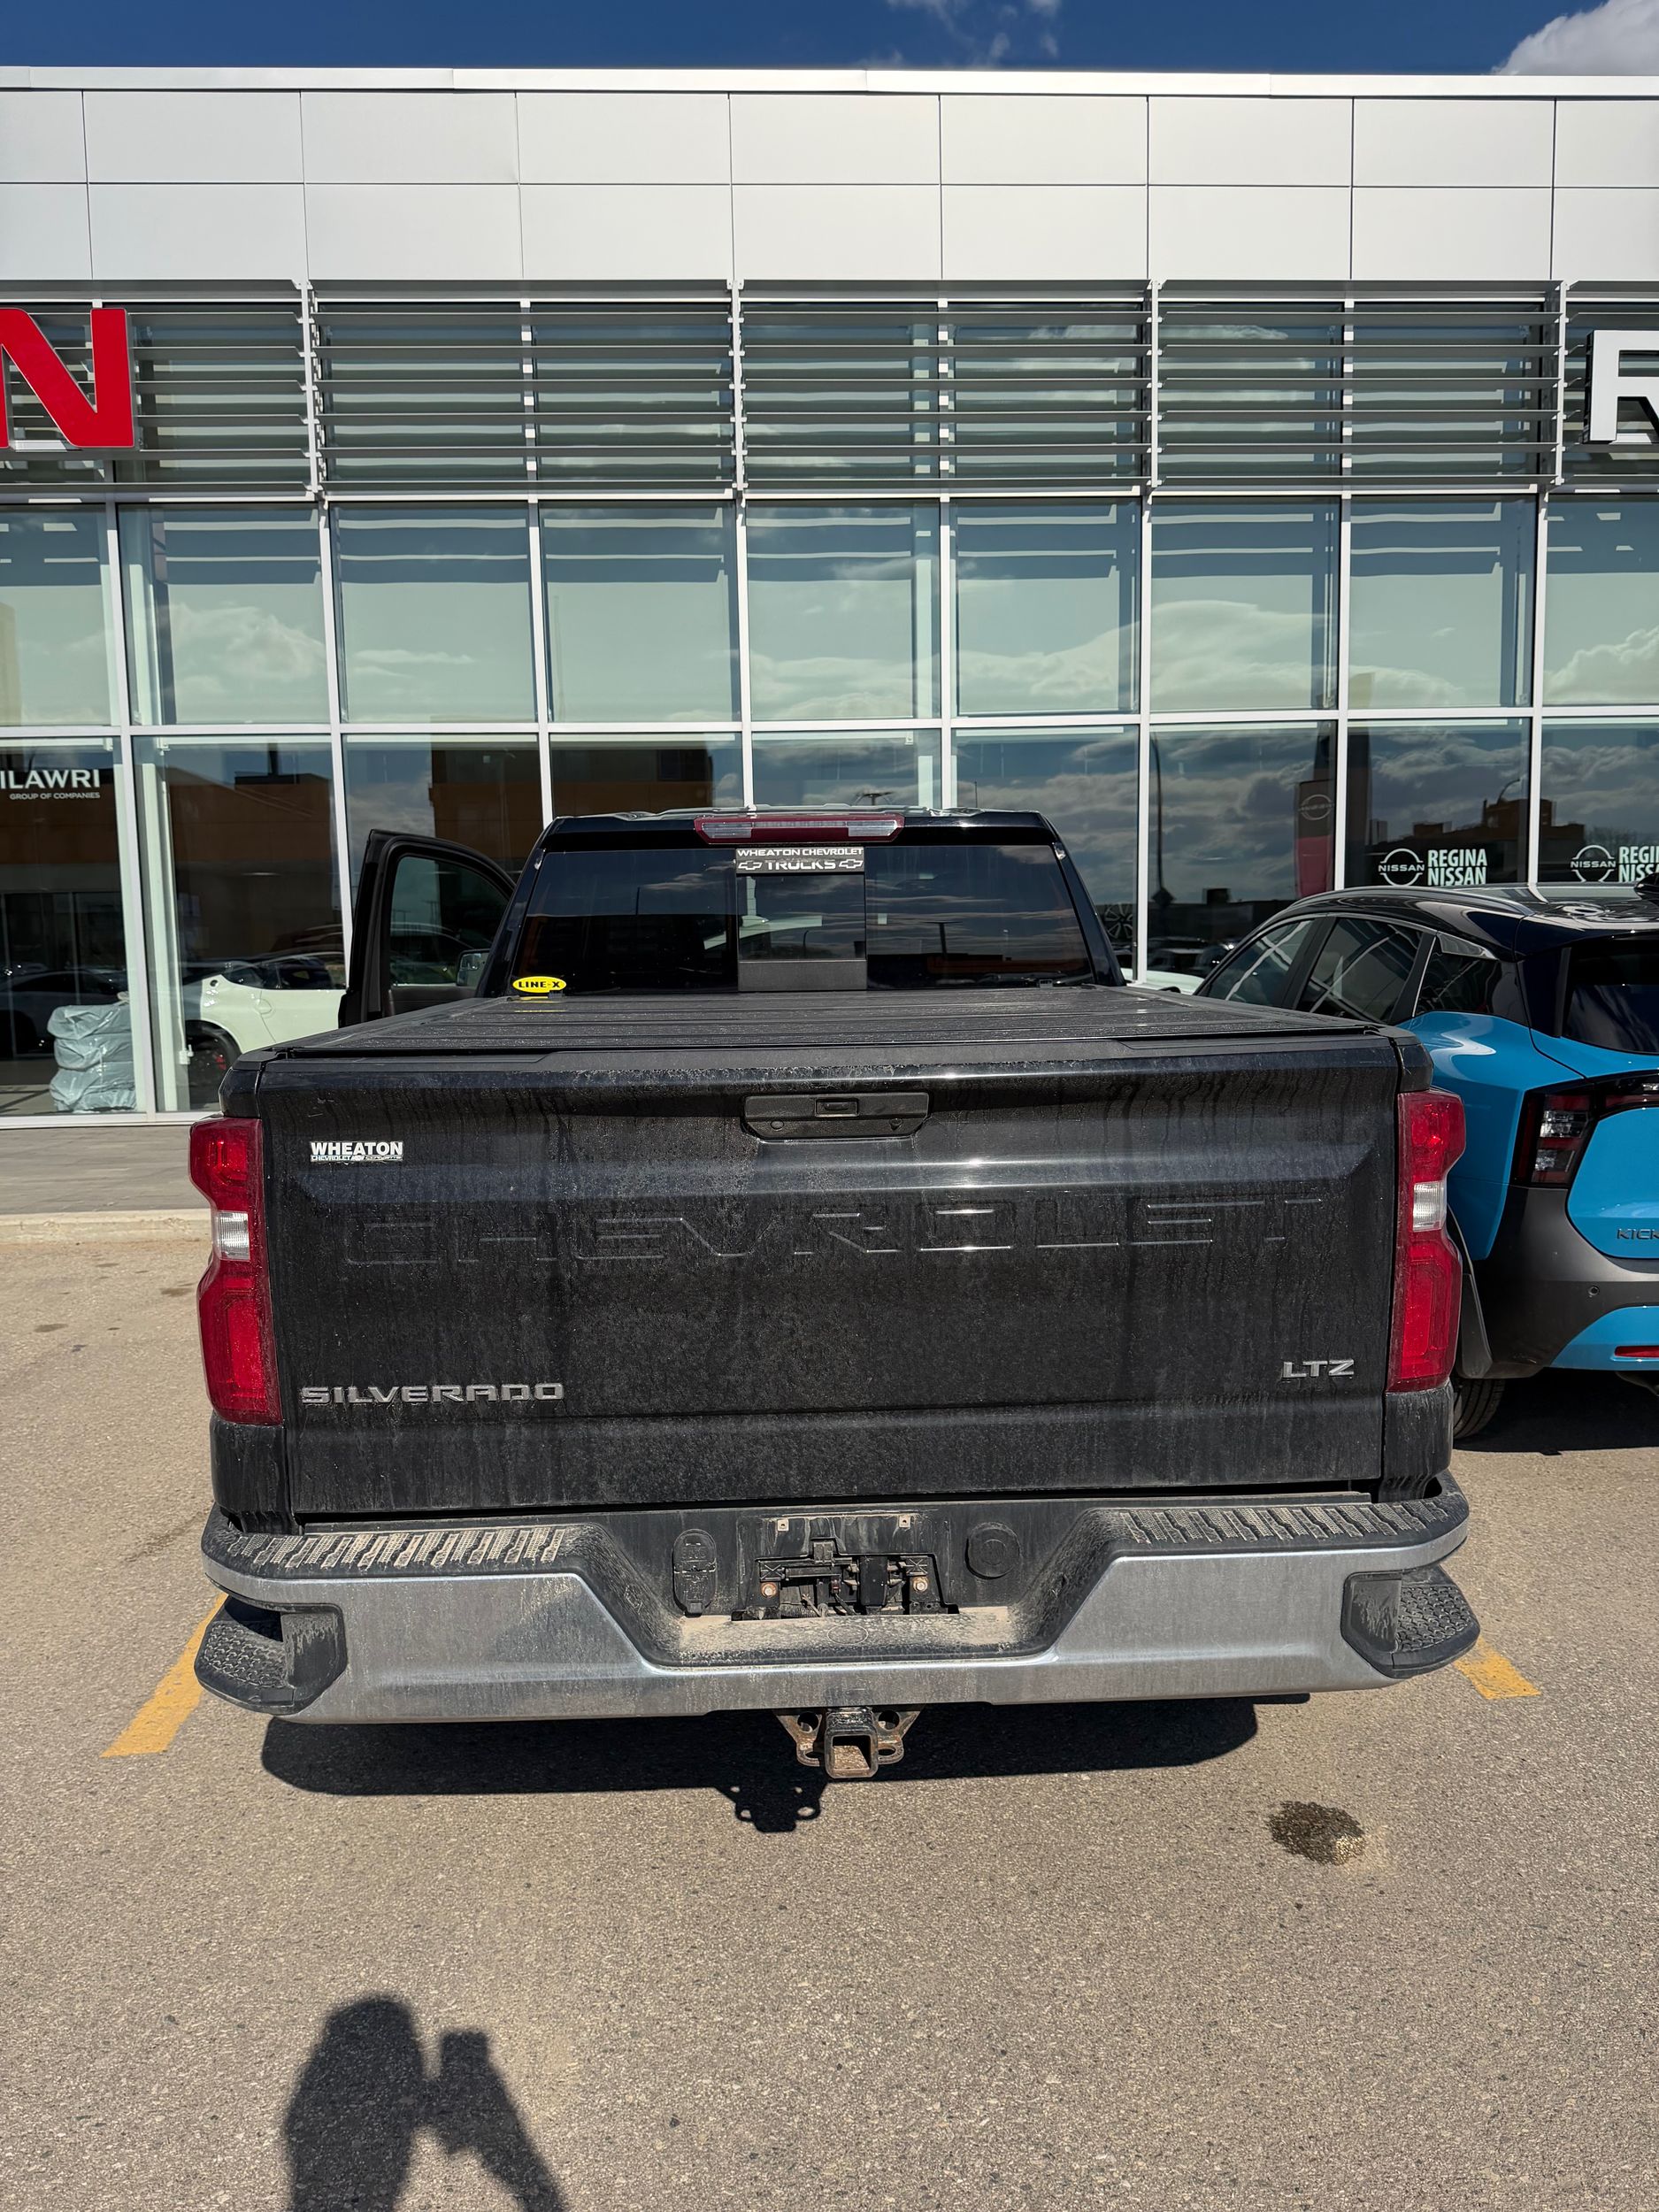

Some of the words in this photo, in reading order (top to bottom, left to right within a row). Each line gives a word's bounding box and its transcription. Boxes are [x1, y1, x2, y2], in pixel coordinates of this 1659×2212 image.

[0, 308, 134, 449] N
[1590, 330, 1659, 441] R
[0, 769, 100, 789] ILAWRI
[765, 859, 836, 870] TRUCKS
[1427, 849, 1487, 867] REGINA
[1427, 867, 1486, 887] NISSAN
[311, 1142, 403, 1156] WHEATON
[343, 1199, 1323, 1263] CHEVROLET
[1283, 1360, 1355, 1379] LTZ
[301, 1383, 565, 1404] SILVERADO
